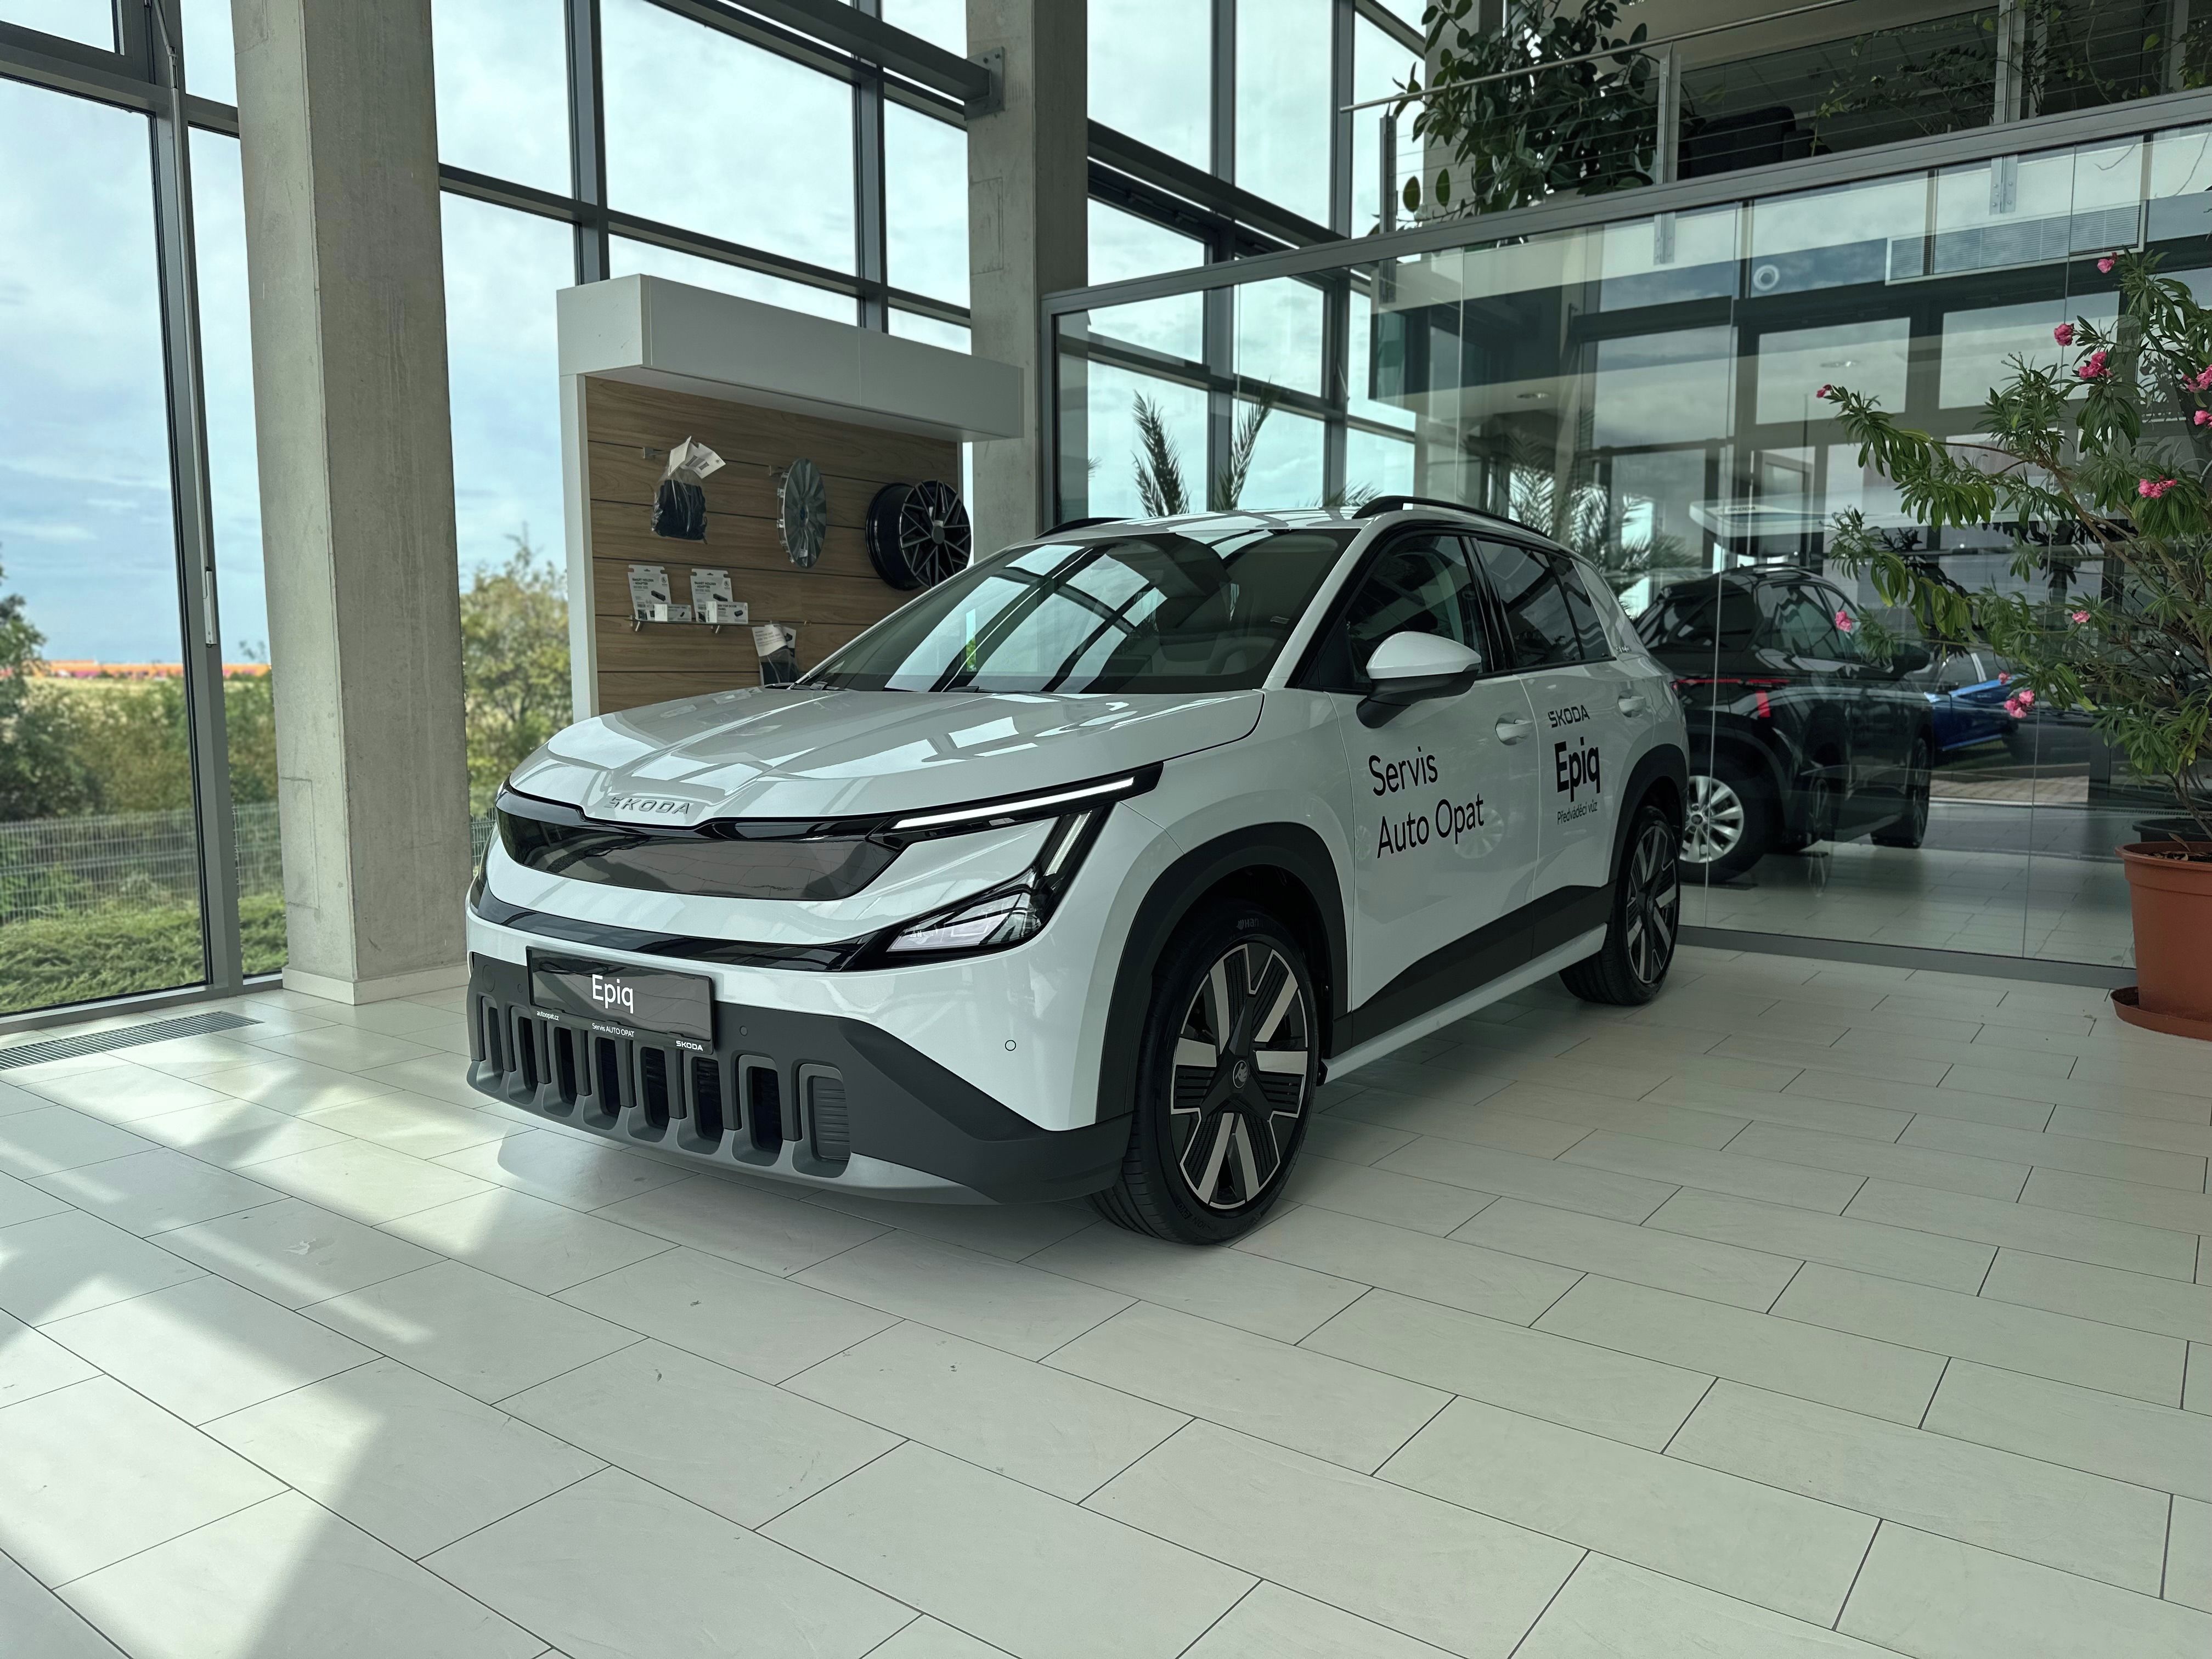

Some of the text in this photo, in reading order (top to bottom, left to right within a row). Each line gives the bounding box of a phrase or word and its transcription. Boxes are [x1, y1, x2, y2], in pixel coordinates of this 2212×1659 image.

[1369, 746, 1438, 796] Servis
[1554, 736, 1600, 802] Epiq
[1377, 793, 1485, 859] Auto Opat
[592, 974, 634, 1014] Epiq
[592, 1023, 635, 1037] Servis AUTO OPAT
